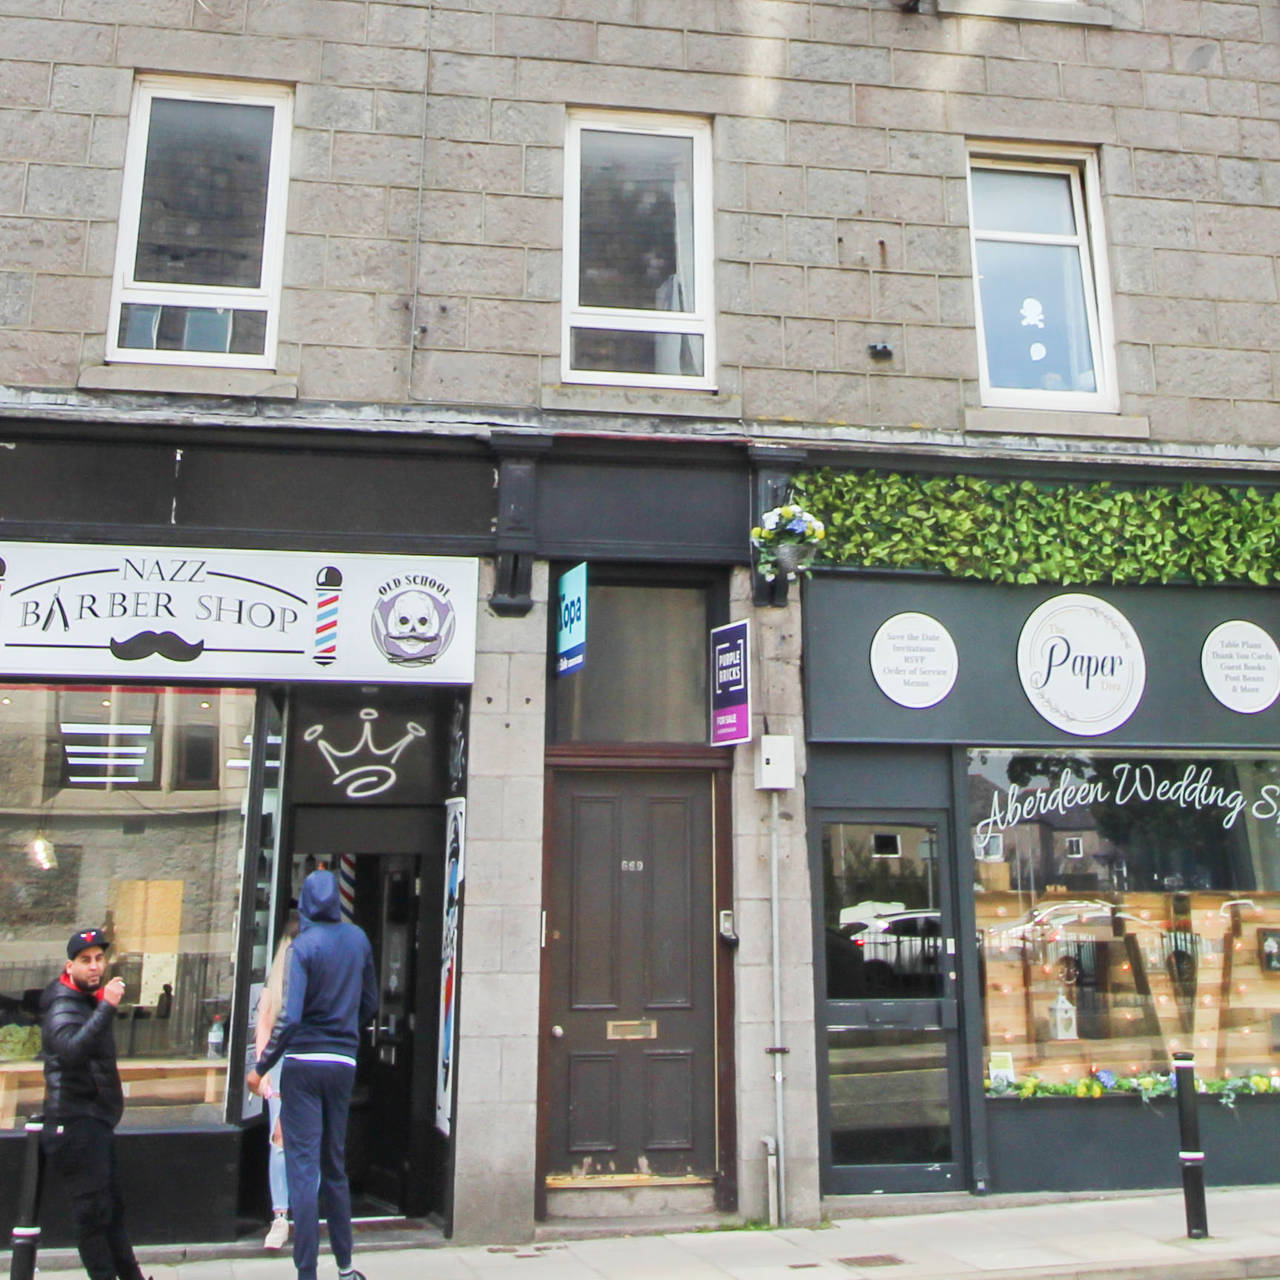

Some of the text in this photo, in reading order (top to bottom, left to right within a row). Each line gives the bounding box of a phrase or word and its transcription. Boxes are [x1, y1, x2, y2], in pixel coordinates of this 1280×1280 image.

[120, 557, 207, 584] NAZZ
[378, 574, 451, 598] OLD SCHOOL
[19, 587, 299, 634] BARBER SHOP
[719, 650, 740, 667] PURPLE
[1030, 635, 1123, 690] Paper
[719, 666, 740, 683] BRICKS
[976, 767, 1110, 847] Aberdeen
[1112, 763, 1247, 829] Wedding
